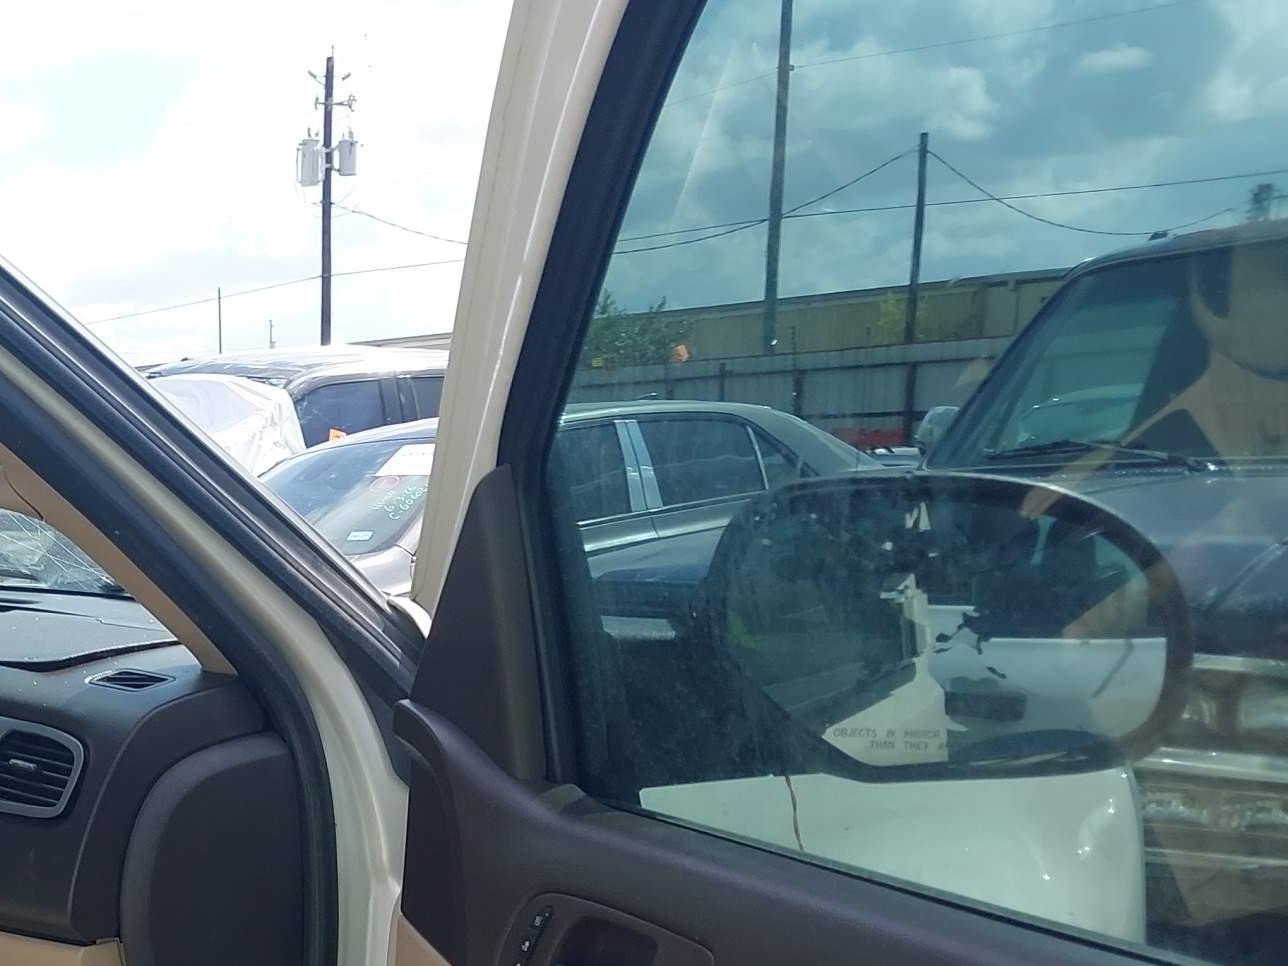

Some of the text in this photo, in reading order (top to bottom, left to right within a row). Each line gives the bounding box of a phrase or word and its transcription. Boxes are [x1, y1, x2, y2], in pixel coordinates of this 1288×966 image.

[833, 727, 877, 738] OBJECTS
[870, 740, 895, 750] THAN
[904, 740, 929, 750] THEY
